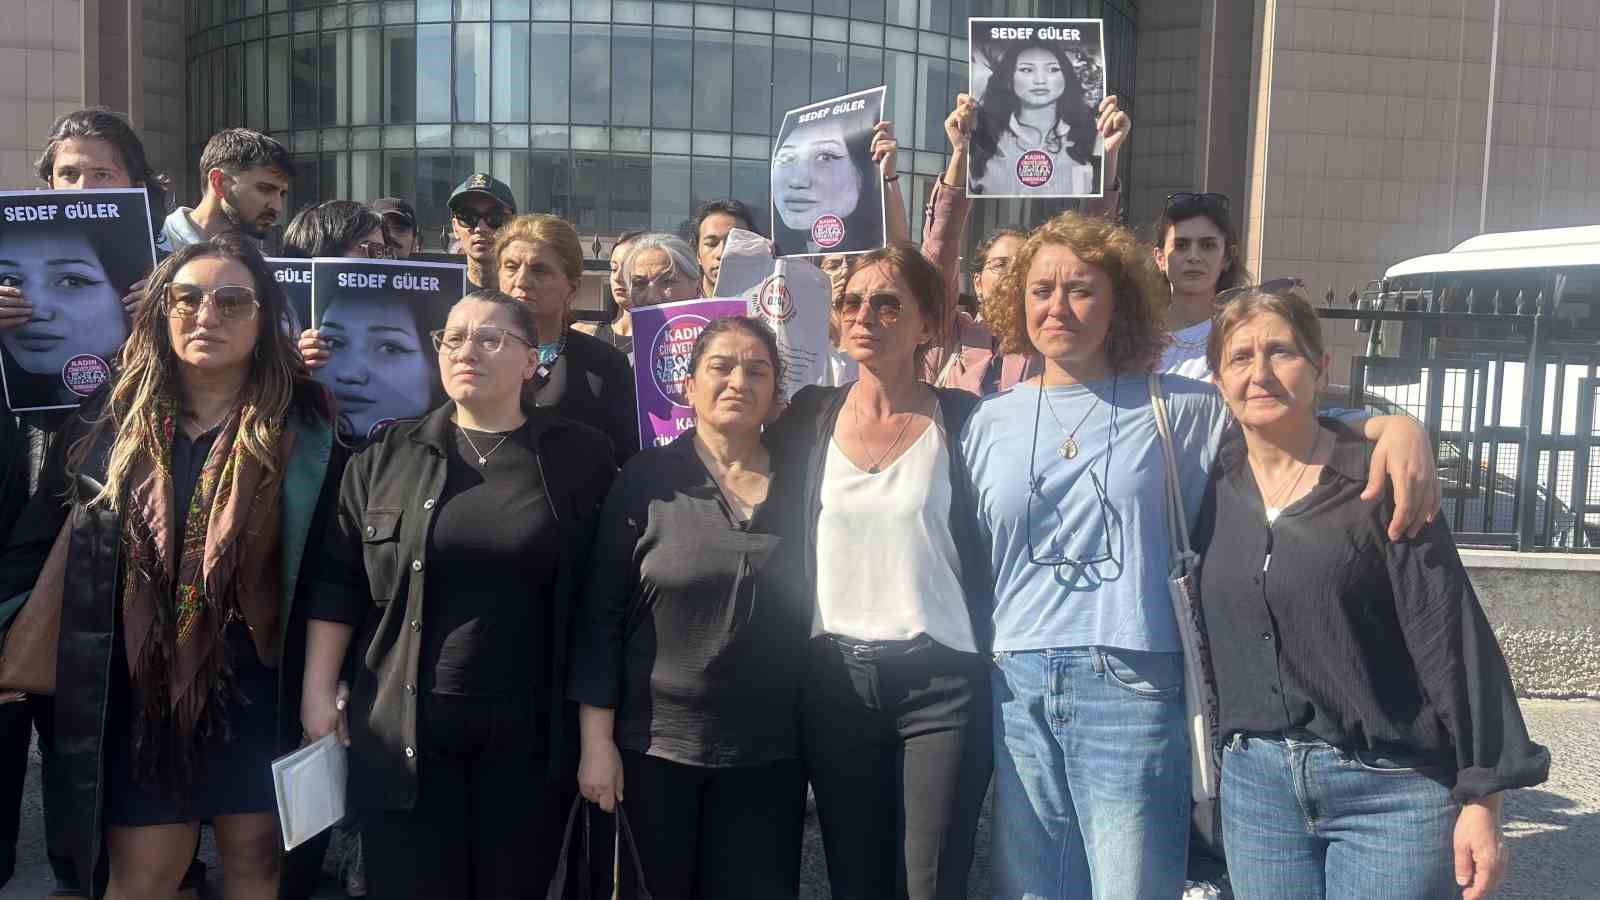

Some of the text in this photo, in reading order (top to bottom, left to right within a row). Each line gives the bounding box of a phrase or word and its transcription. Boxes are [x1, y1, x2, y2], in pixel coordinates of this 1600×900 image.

[991, 26, 1081, 40] SEDEF GÜLER
[798, 99, 866, 124] SEDEF GÜLER
[4, 201, 121, 222] SEDEF GÜLER
[274, 268, 312, 284] GÜLE
[337, 272, 440, 292] SEDEF GÜLER
